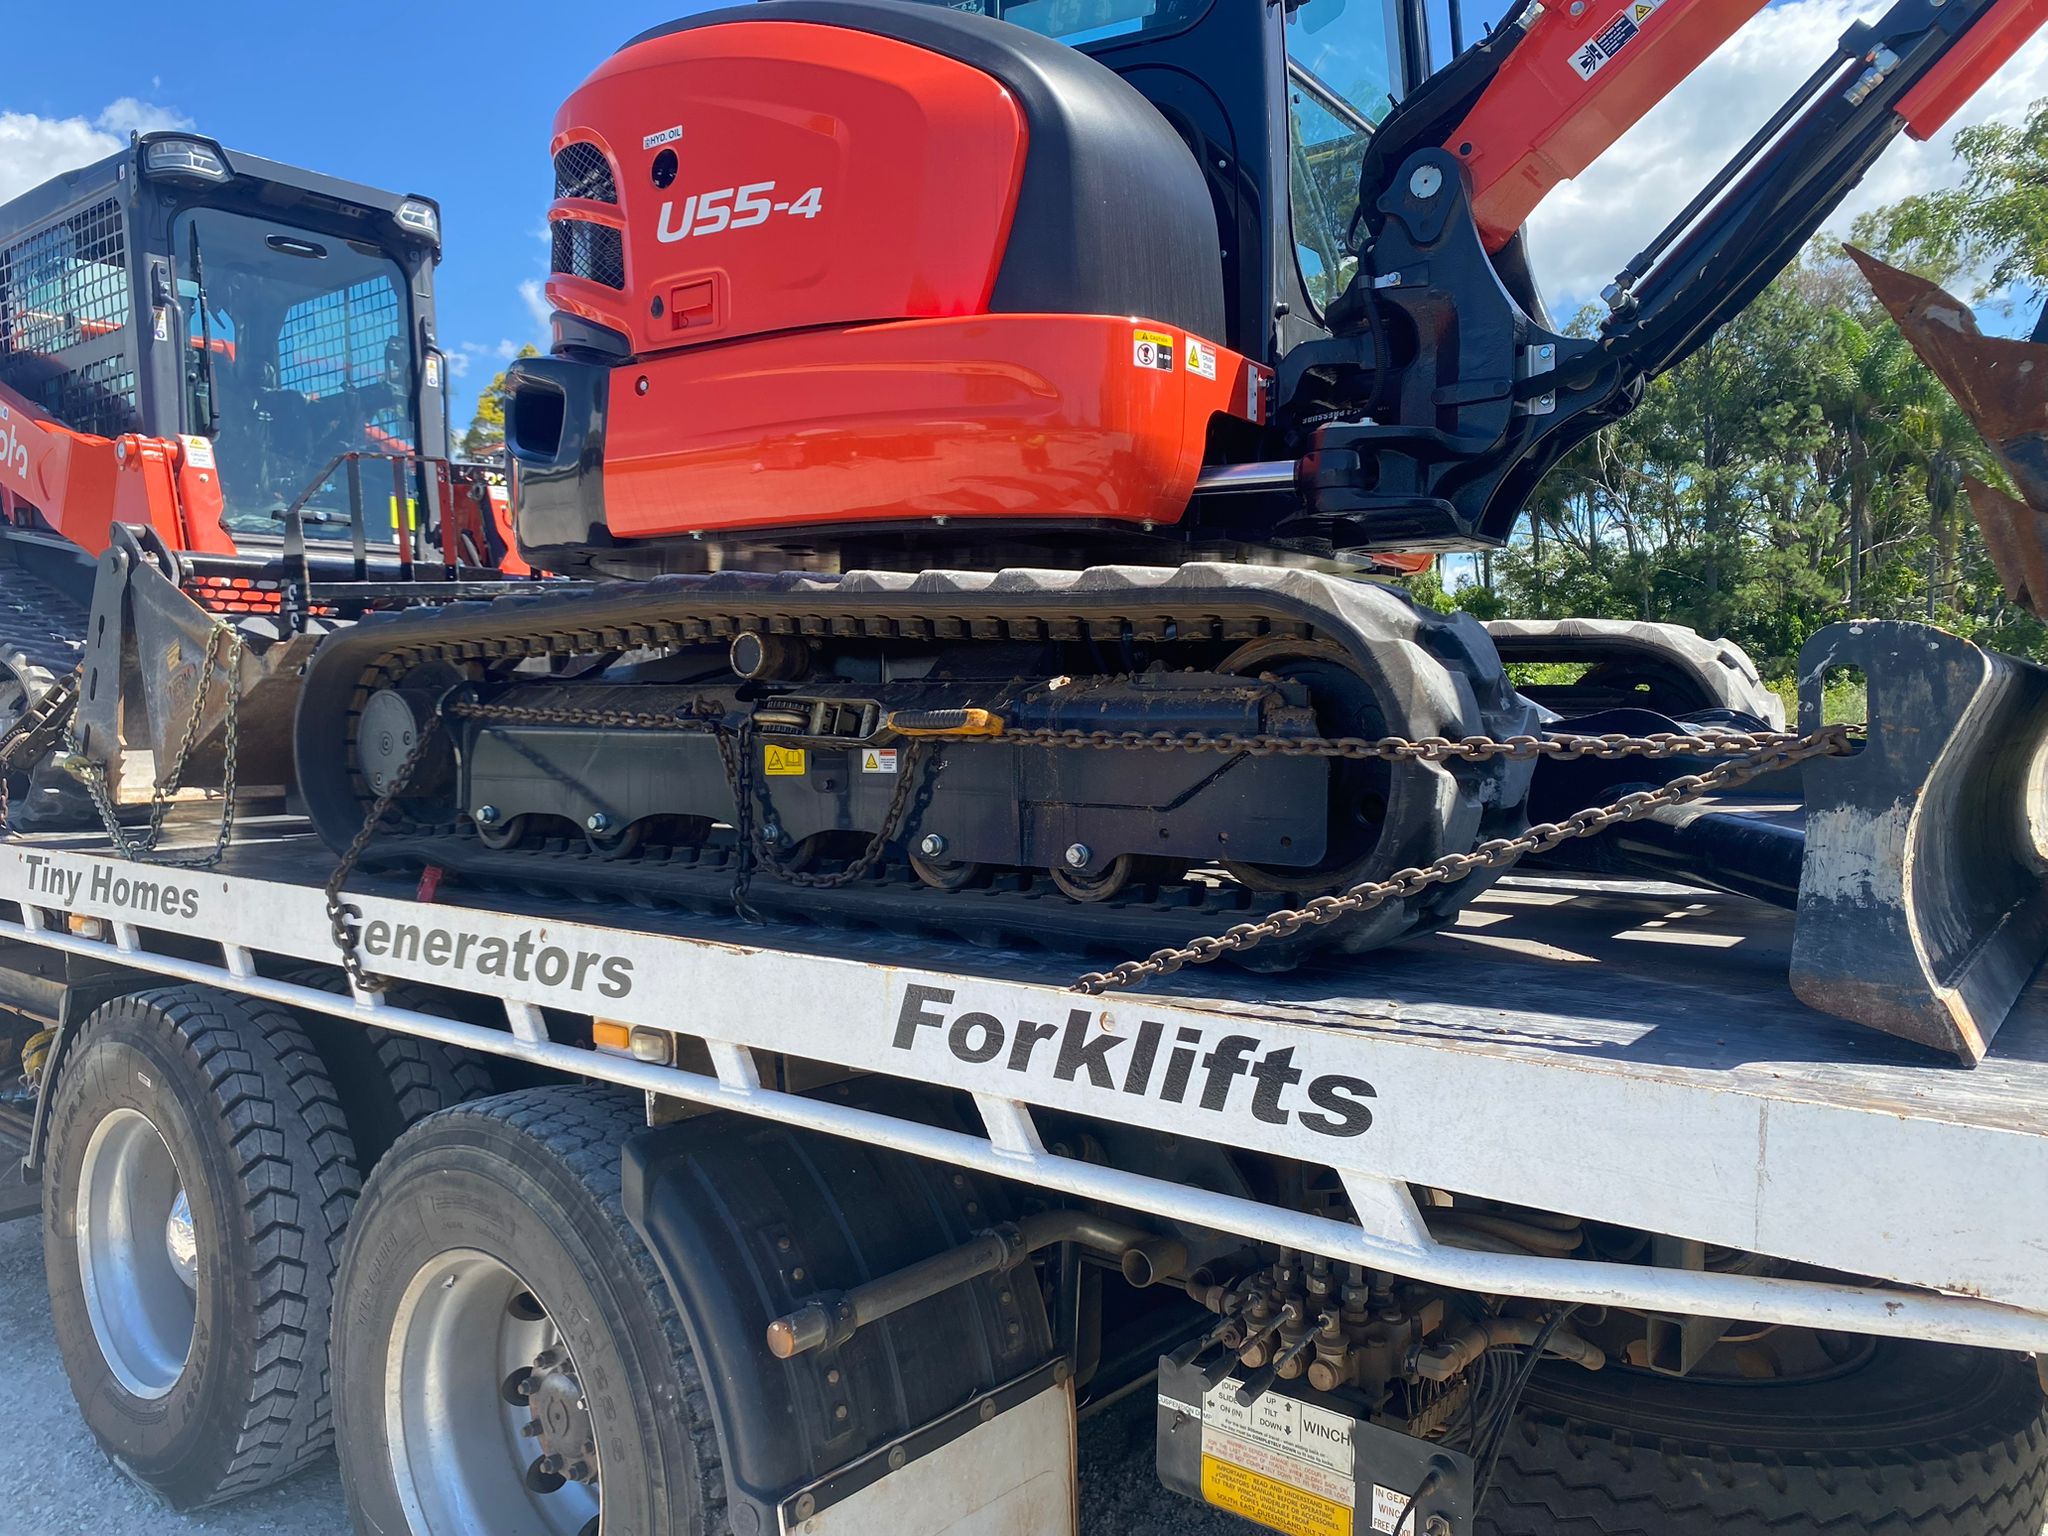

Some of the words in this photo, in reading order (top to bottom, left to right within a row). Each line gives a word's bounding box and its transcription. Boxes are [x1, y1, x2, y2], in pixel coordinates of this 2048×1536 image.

[650, 134, 667, 145] HYD.
[669, 128, 680, 138] OIL
[656, 181, 823, 244] U55-4
[25, 855, 83, 907] Tiny
[90, 866, 200, 919] Homes
[331, 903, 635, 1000] Generators
[891, 983, 1378, 1137] Forklifts
[1222, 1382, 1239, 1392] (OUT
[1266, 1396, 1276, 1404] UP
[1196, 1410, 1212, 1419] DMP
[1220, 1404, 1231, 1416] ON
[1232, 1408, 1243, 1419] (IN)
[1264, 1408, 1278, 1418] TILT
[1260, 1418, 1282, 1432] DOWN
[1304, 1420, 1351, 1446] WINCH
[1216, 1464, 1247, 1481] IMPORTANT
[1253, 1478, 1268, 1489] READ
[1270, 1484, 1282, 1494] AND
[1284, 1490, 1322, 1510] UNDERSTAND
[1376, 1488, 1384, 1497] IN
[1222, 1480, 1235, 1490] TRAY
[1260, 1494, 1289, 1511] UNDERLIFT
[1291, 1506, 1299, 1515] OR
[1252, 1484, 1276, 1499] MANUAL
[1277, 1494, 1299, 1508] BEFORE
[1217, 1493, 1238, 1506] SOUTH
[1240, 1501, 1255, 1513] EAST
[1258, 1508, 1301, 1531] QUEENSLAND
[1261, 1502, 1290, 1519] AVAILABLE
[1378, 1504, 1401, 1519] WINC
[1374, 1518, 1390, 1532] FREE
